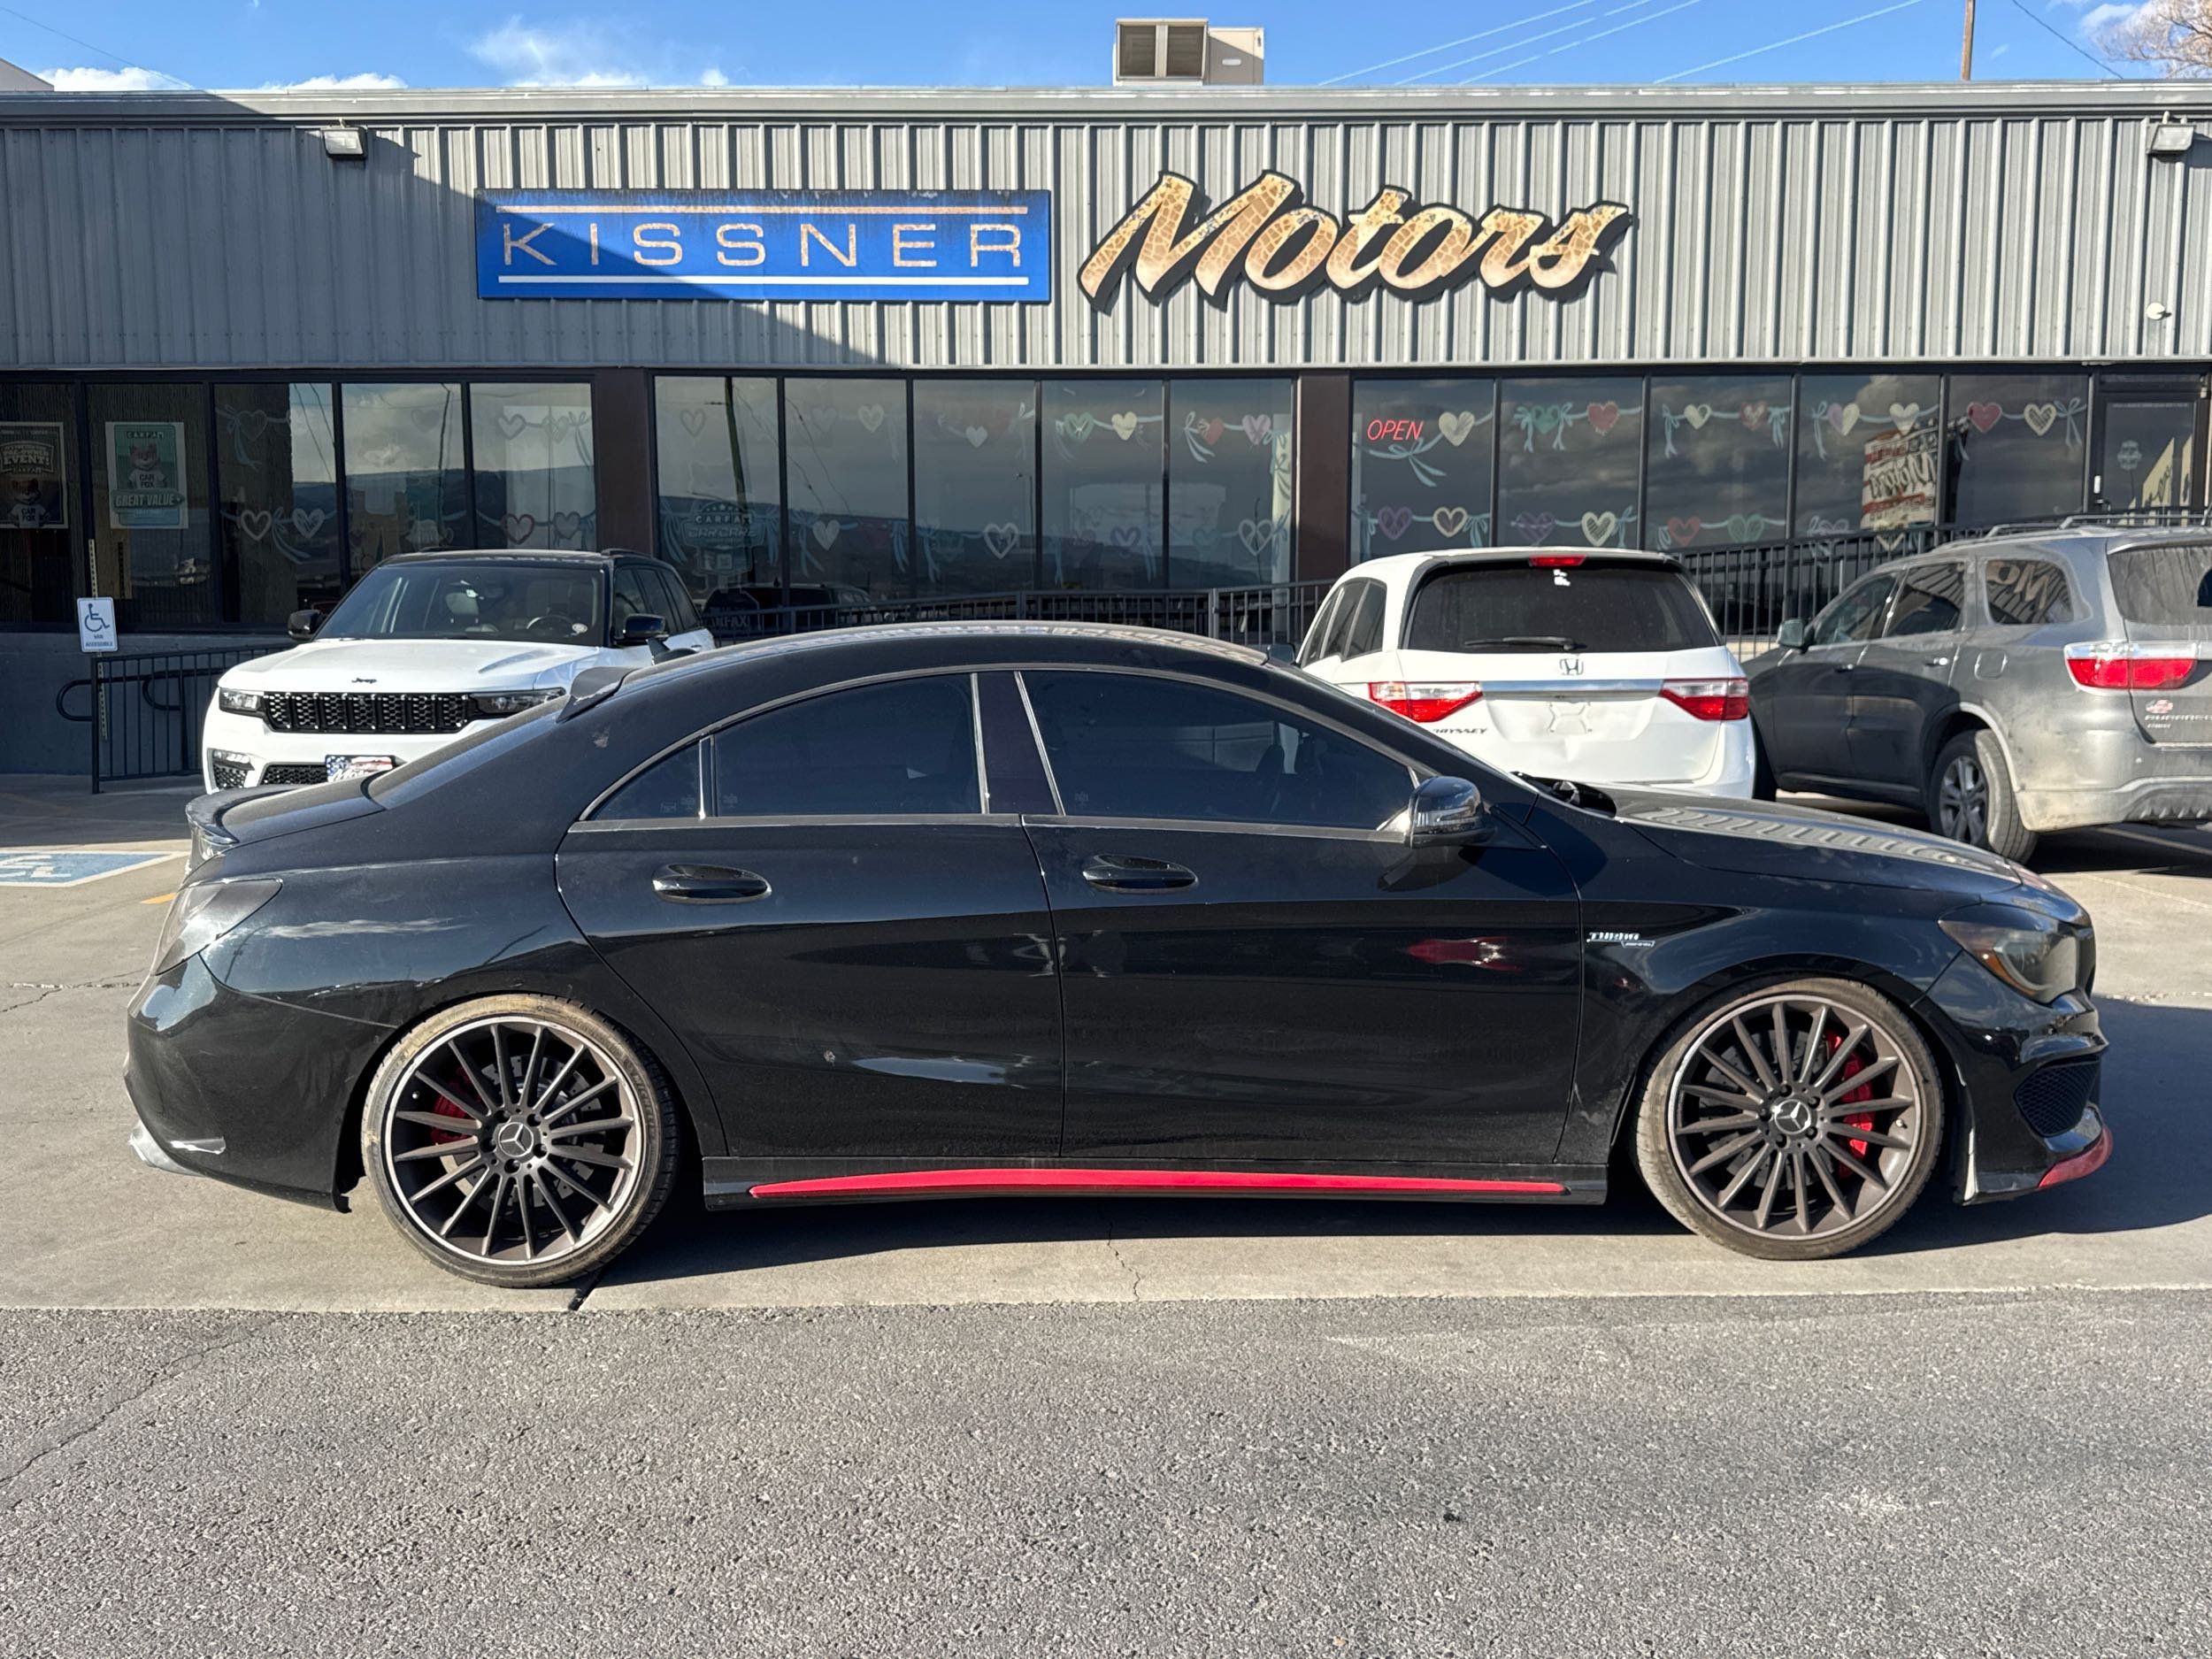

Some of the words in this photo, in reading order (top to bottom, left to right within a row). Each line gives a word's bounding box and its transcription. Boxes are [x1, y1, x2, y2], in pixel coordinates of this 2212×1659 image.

[503, 221, 1022, 268] KISSNER
[1078, 169, 1635, 310] Motors
[1366, 419, 1424, 441] OPEN
[115, 494, 145, 507] GREAT
[147, 493, 175, 506] VALUE
[695, 514, 753, 525] CARFAX
